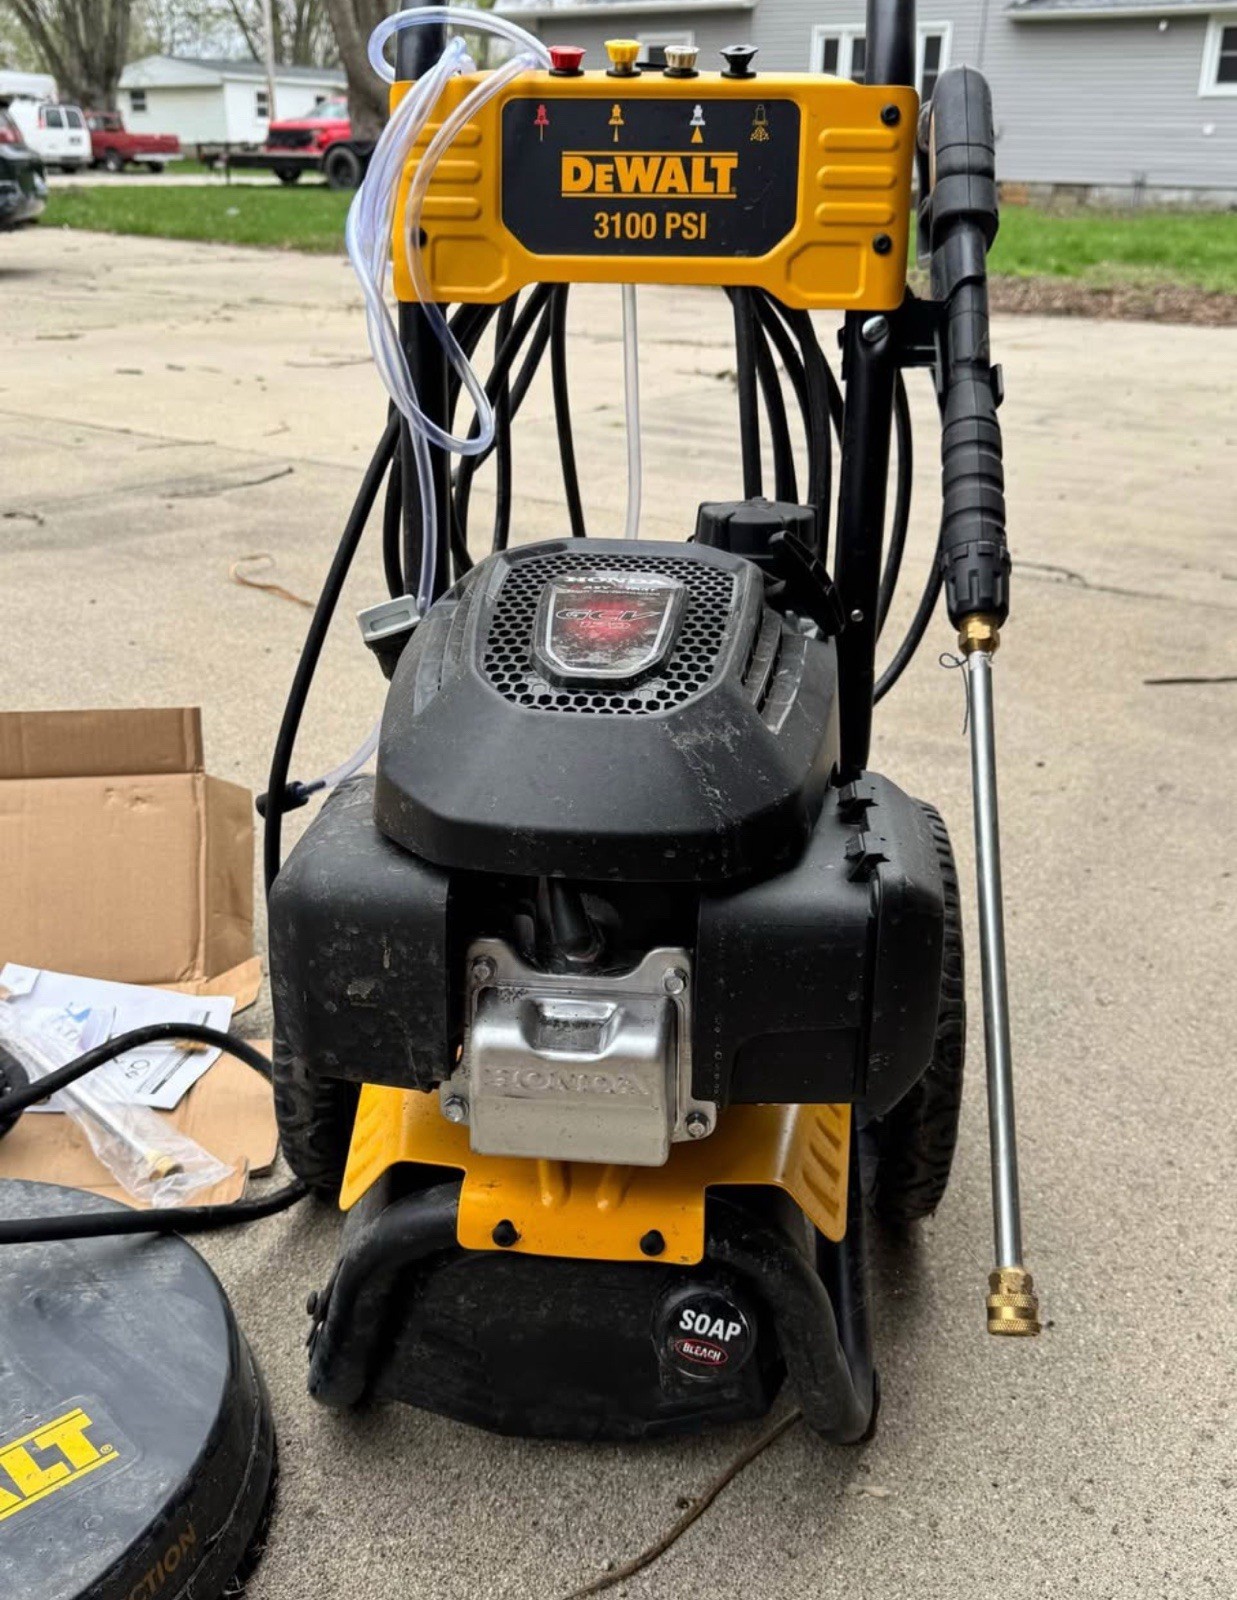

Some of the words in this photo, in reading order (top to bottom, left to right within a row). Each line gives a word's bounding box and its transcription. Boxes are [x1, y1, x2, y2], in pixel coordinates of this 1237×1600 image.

[562, 157, 738, 193] DEWALT
[593, 212, 657, 239] 3100
[665, 212, 706, 239] PSI
[483, 1065, 649, 1095] HONDA
[679, 1309, 741, 1342] SOAP
[682, 1342, 722, 1361] BLEACH
